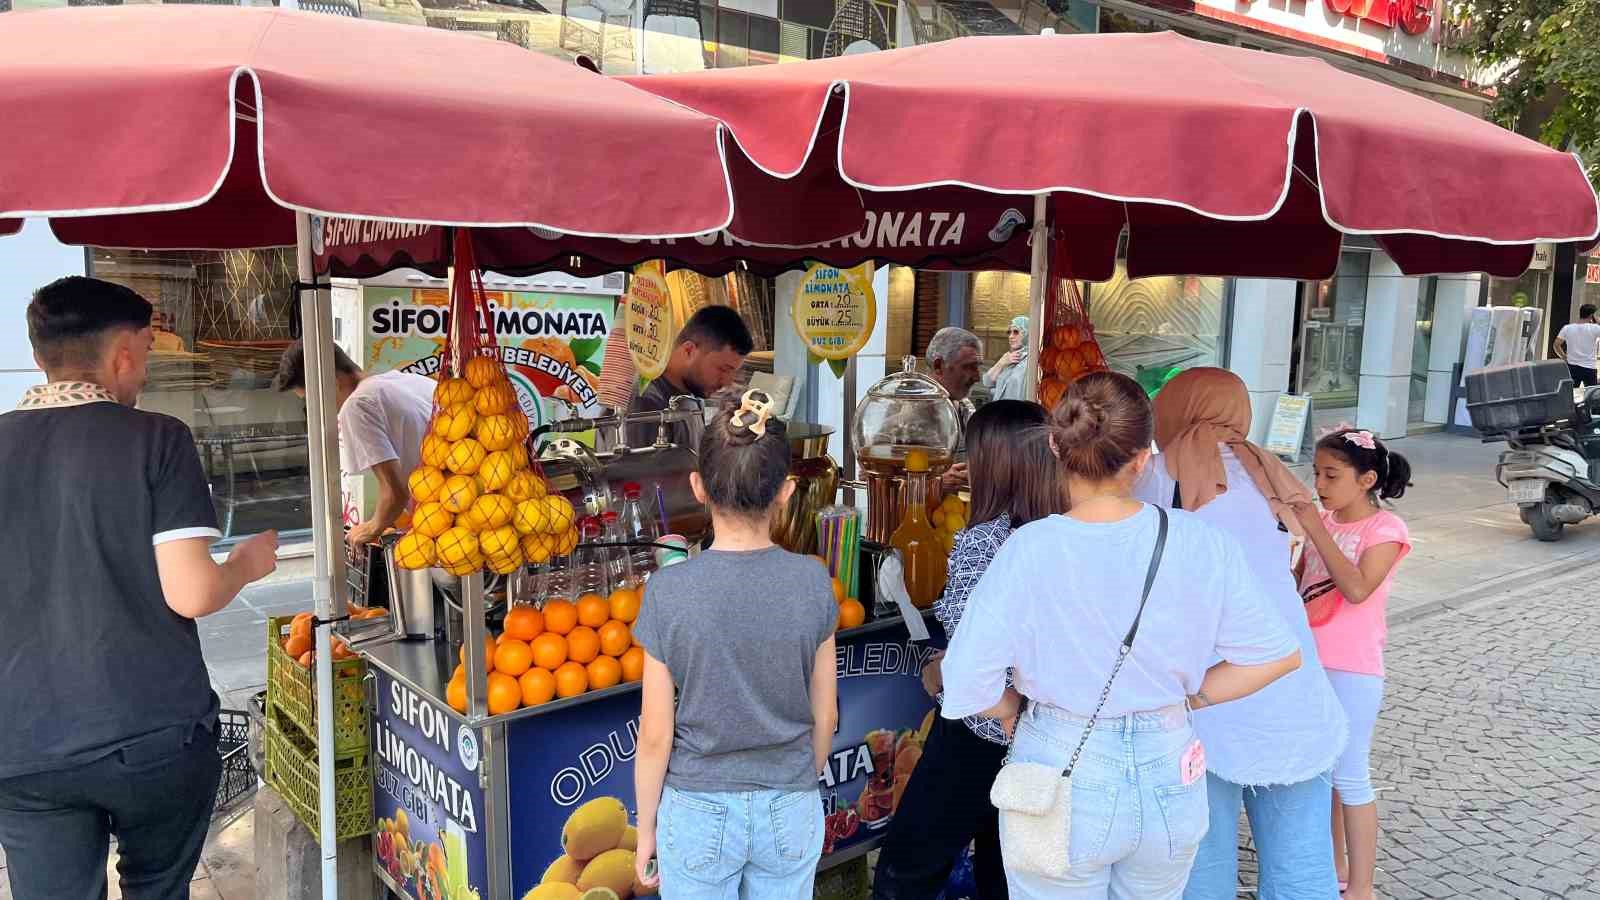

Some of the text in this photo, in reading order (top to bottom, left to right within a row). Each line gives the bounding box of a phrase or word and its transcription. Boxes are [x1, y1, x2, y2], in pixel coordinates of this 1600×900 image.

[837, 310, 852, 324] 25
[503, 347, 598, 409] BELEDİYESİ
[835, 640, 935, 679] ELEDİY
[391, 680, 450, 752] SIFON
[376, 720, 478, 833] LİMONATA
[550, 716, 641, 806] ODU
[818, 743, 875, 788] ATA
